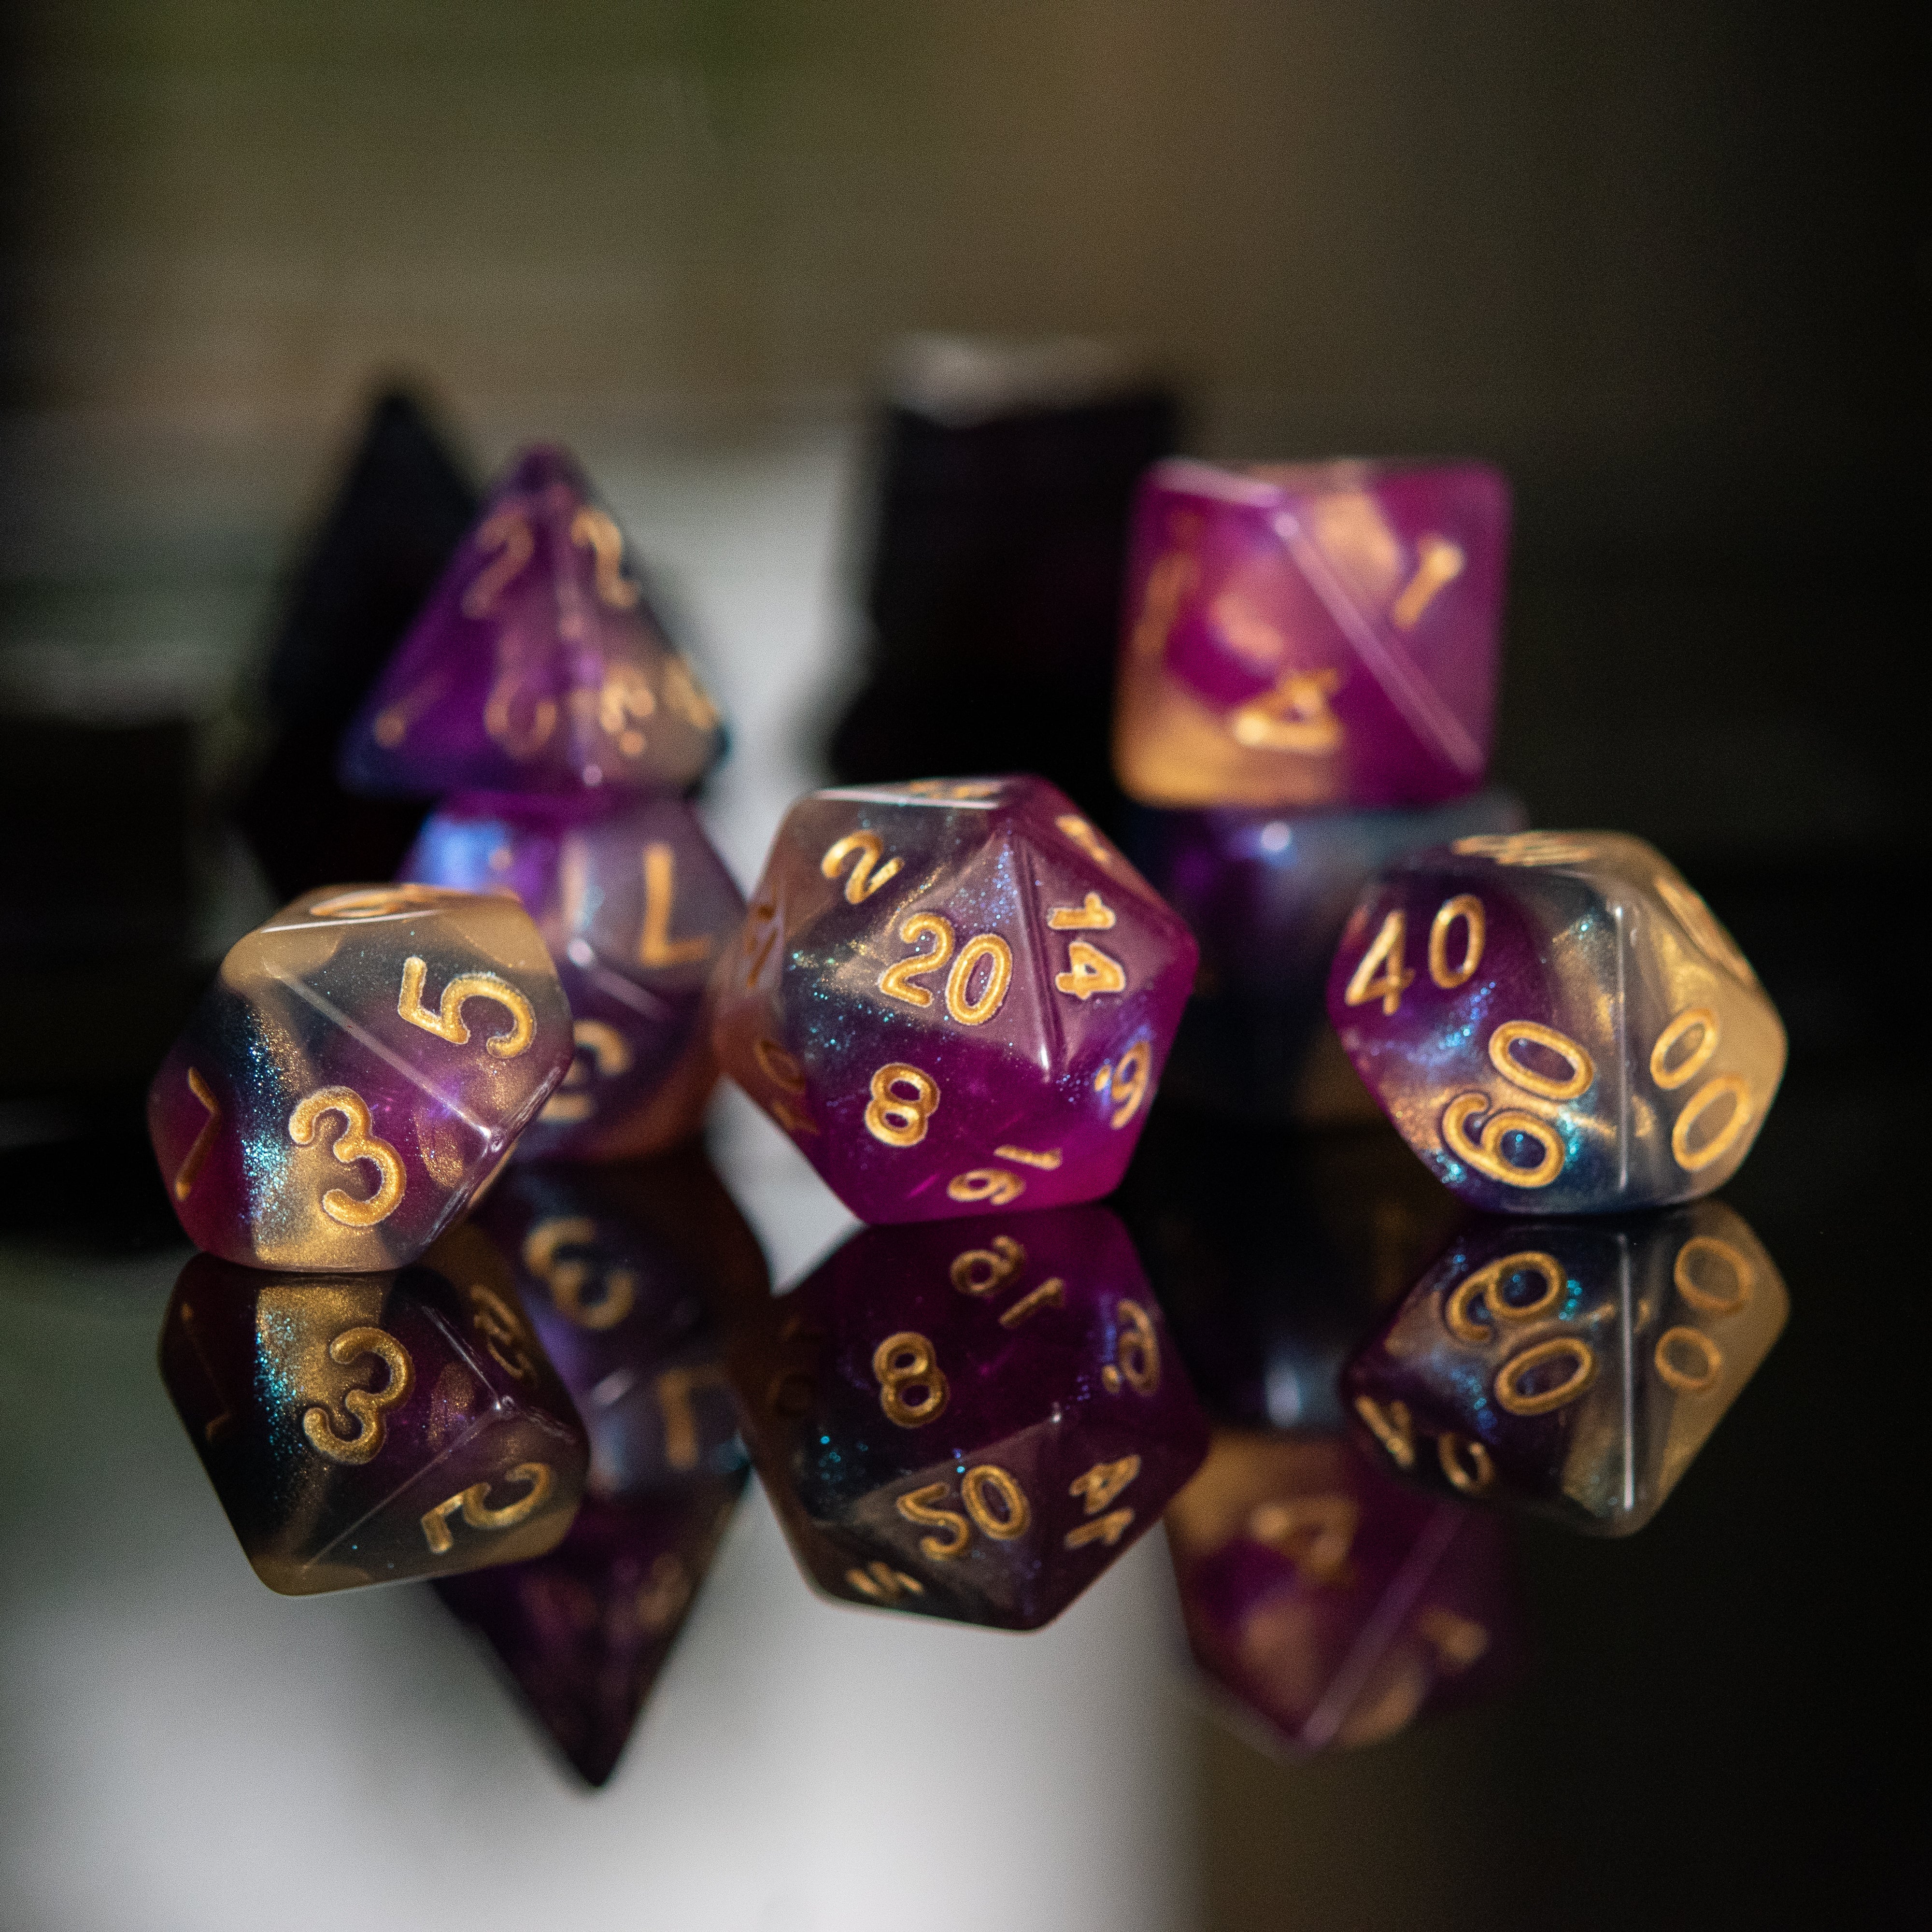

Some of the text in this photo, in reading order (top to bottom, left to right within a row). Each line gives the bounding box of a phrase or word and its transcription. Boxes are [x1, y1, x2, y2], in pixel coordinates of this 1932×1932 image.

[821, 830, 905, 905] 2
[878, 912, 1013, 1026] 20
[1048, 892, 1126, 1000] 14
[1345, 893, 1486, 1015] 40
[398, 956, 537, 1059] 5
[289, 1086, 407, 1227] 3
[865, 1063, 940, 1147] 8
[1442, 1020, 1594, 1189] 60
